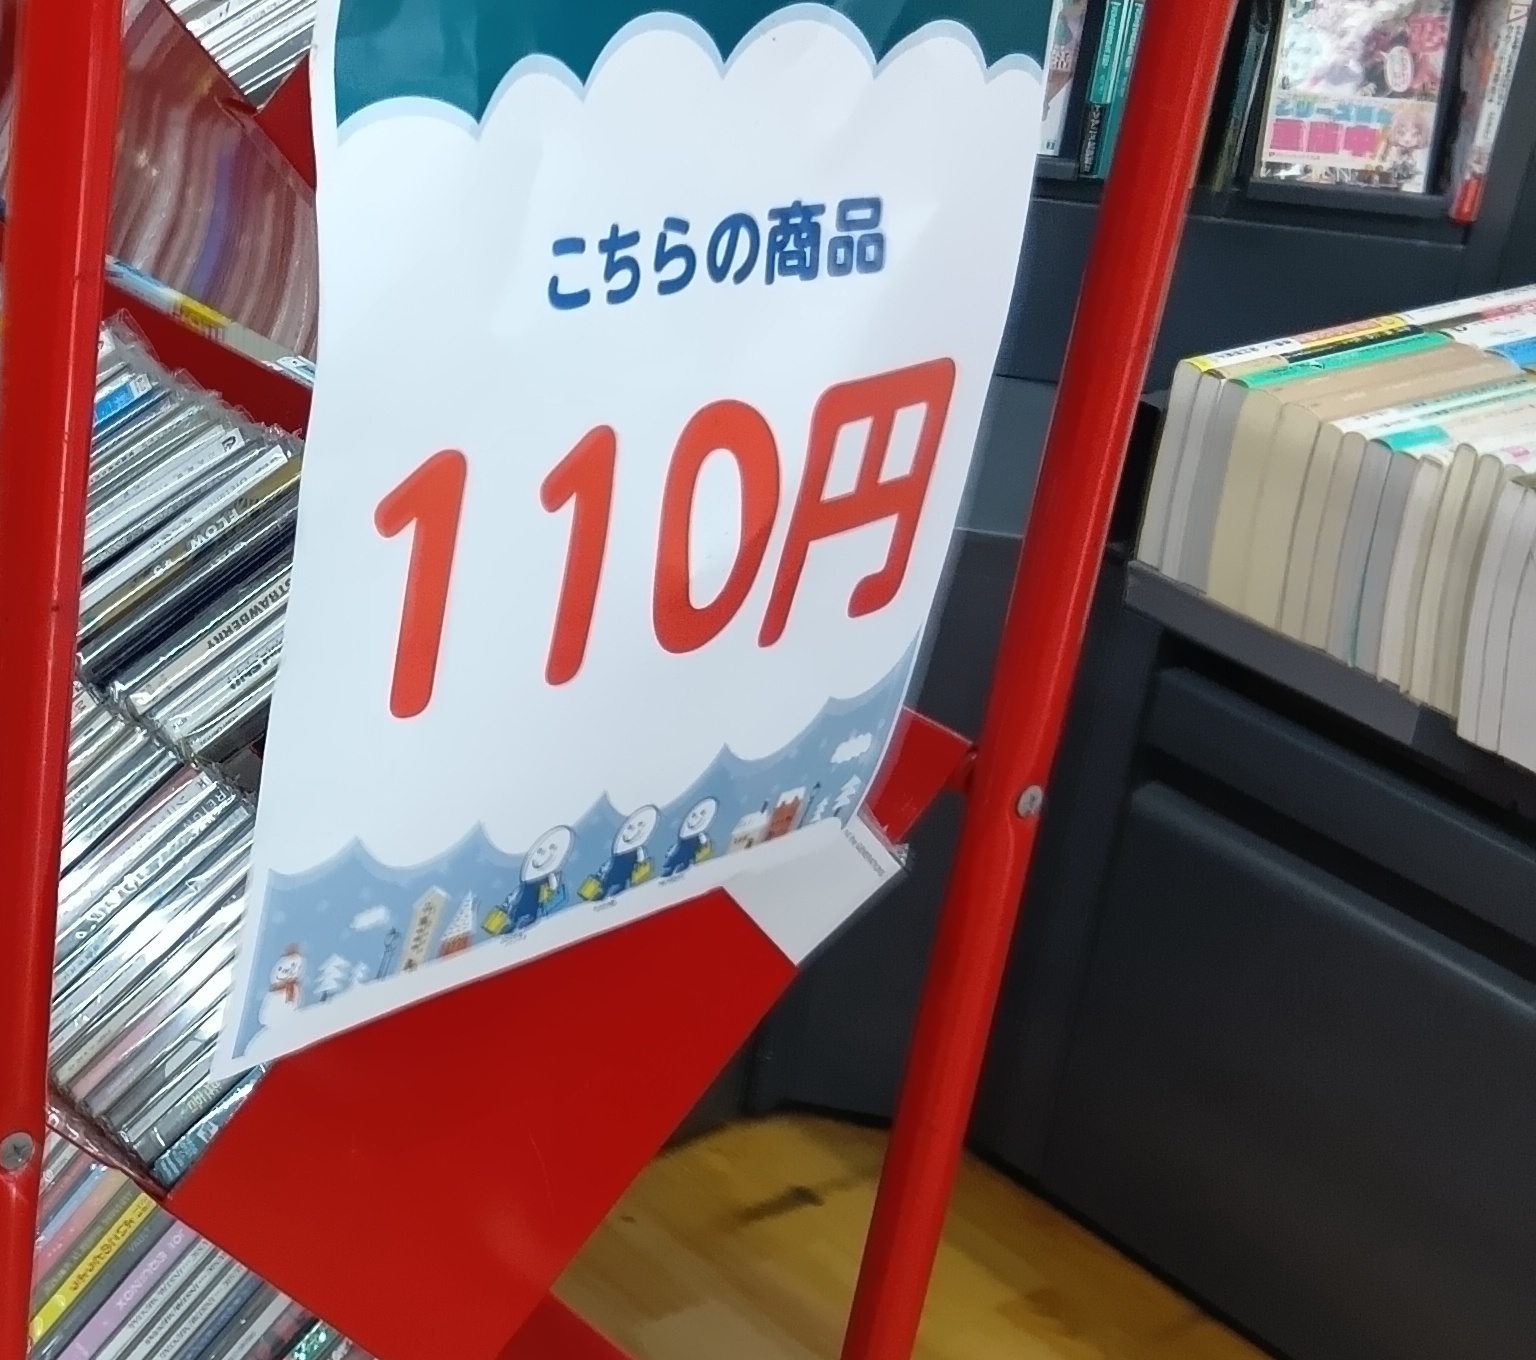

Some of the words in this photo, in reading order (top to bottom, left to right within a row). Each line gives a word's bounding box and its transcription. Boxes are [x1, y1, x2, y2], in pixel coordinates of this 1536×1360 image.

[547, 197, 886, 310] こちらの商品
[183, 506, 241, 551] FLOW
[374, 356, 956, 719] 110円
